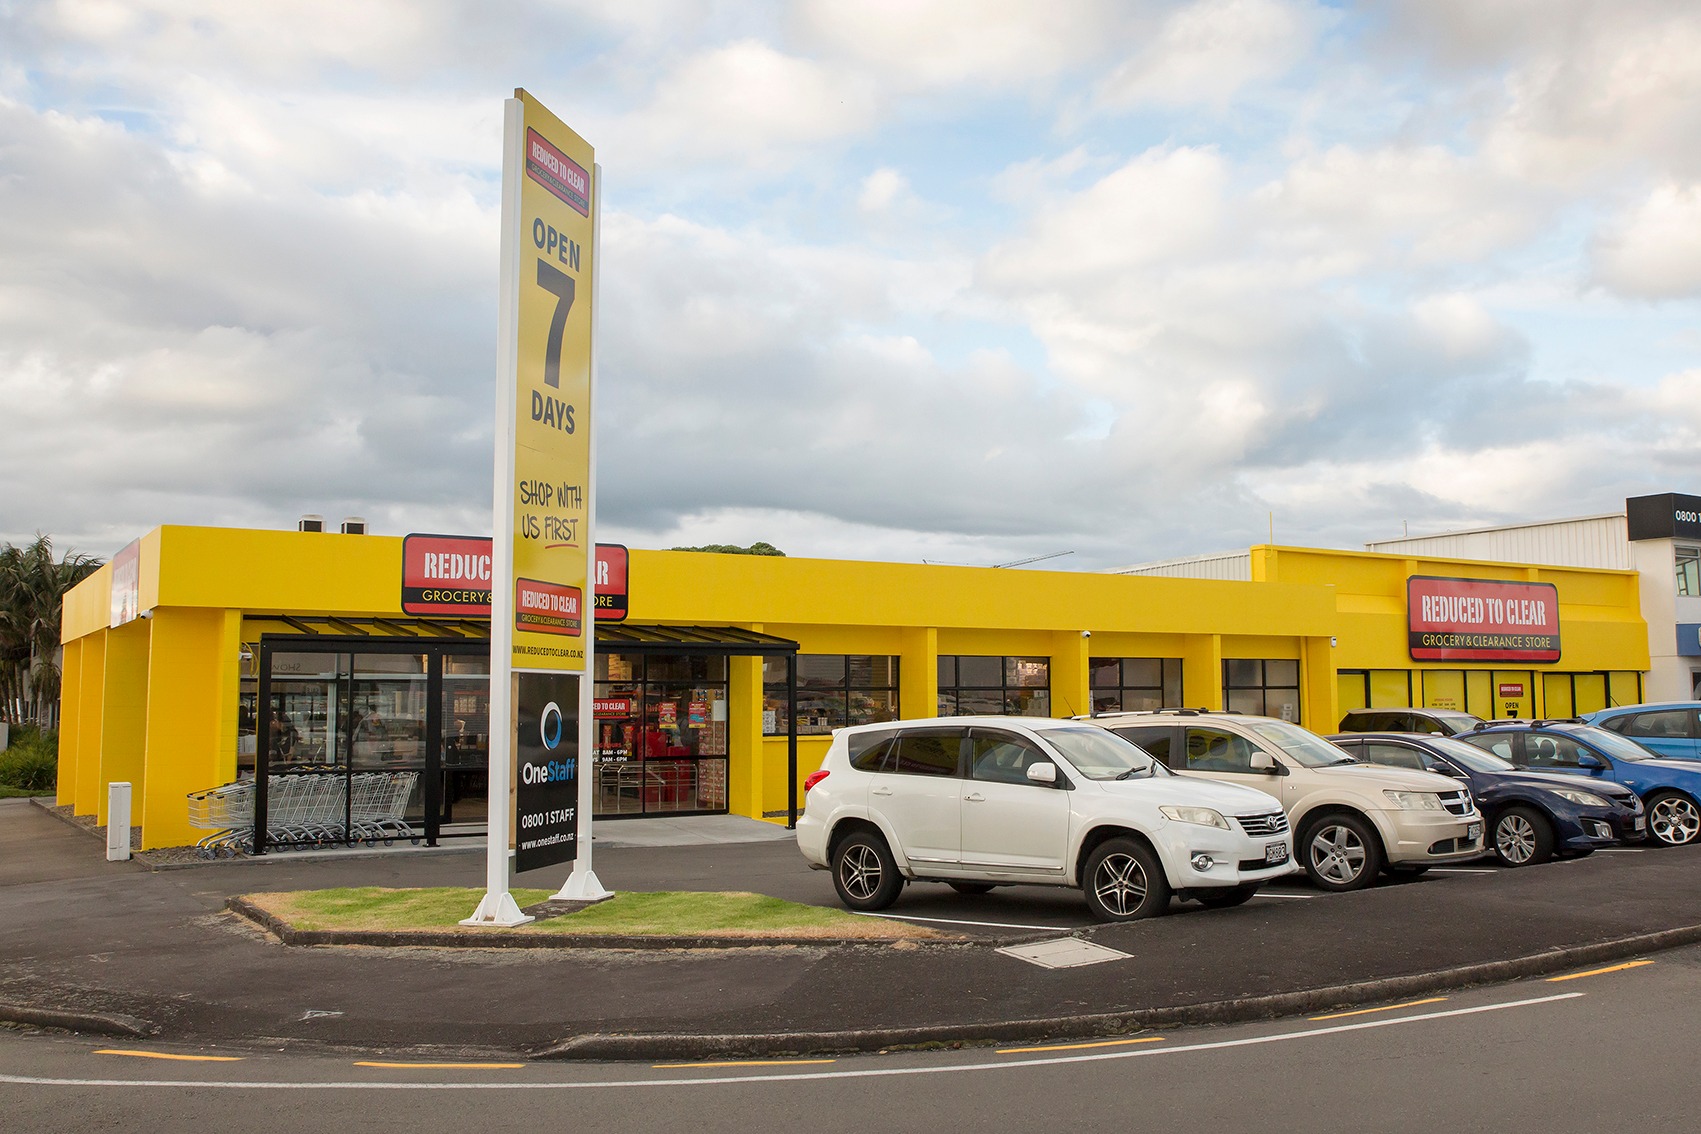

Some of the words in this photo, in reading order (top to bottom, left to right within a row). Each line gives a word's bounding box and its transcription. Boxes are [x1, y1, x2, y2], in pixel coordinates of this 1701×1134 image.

[532, 141, 559, 174] REDUCED
[559, 161, 567, 180] TO
[567, 168, 585, 194] CLEAR
[533, 217, 581, 273] OPEN
[537, 257, 576, 389] 7
[531, 389, 575, 435] DAYS
[519, 480, 553, 508] SHOP
[557, 481, 582, 510] WITH
[522, 513, 540, 540] US
[544, 516, 579, 542] FIRST
[1675, 510, 1697, 523] 0800
[424, 552, 492, 581] REDUC
[522, 590, 550, 610] REDUCED
[550, 594, 559, 611] TO
[559, 595, 577, 614] CLEAR
[1421, 595, 1485, 624] REDUCED
[1486, 598, 1503, 625] TO
[1506, 599, 1547, 626] CLEAR
[512, 645, 584, 659] WWW.REDUCEDTOCLEAR.CO.NZ
[1525, 636, 1551, 648] STORE
[601, 702, 608, 710] TO
[608, 702, 626, 710] CLEAR
[522, 758, 576, 785] OneStaff
[521, 812, 544, 829] 0800
[550, 808, 575, 824] STAFF
[521, 832, 575, 851] www.onestaff.co.nz
